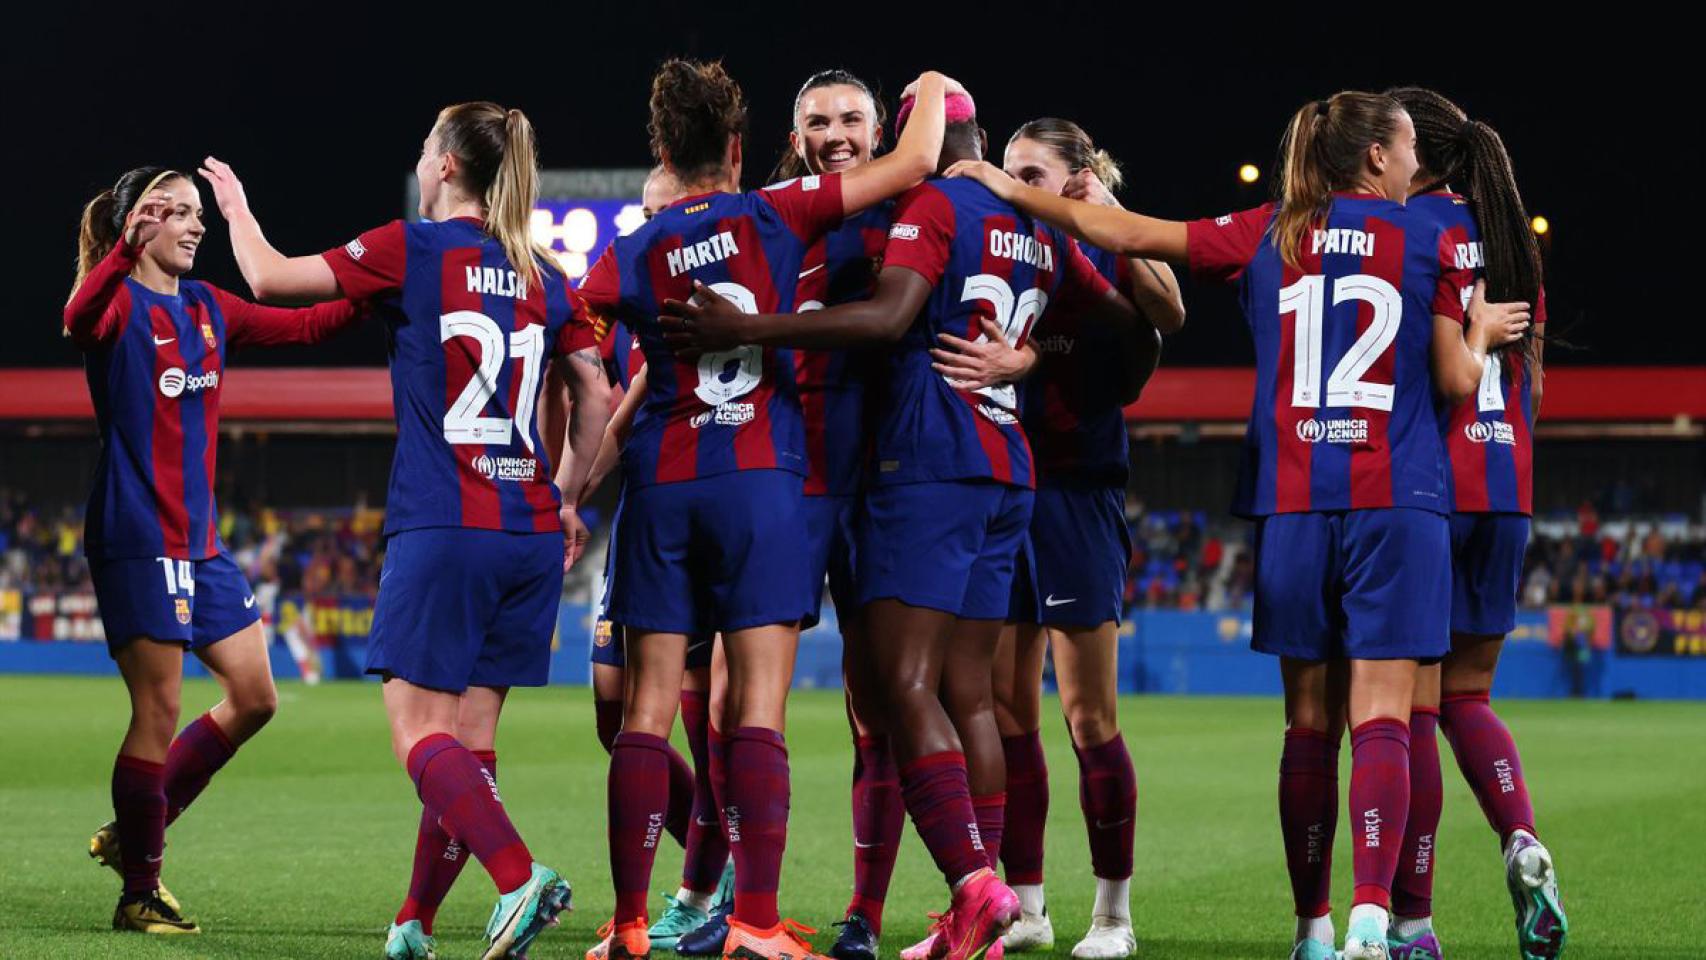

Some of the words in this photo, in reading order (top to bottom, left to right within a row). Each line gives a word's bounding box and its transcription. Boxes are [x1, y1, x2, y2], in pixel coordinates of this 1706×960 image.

[666, 231, 739, 277] MARTA
[1312, 229, 1375, 256] PATRI
[466, 266, 527, 300] WALSH
[1279, 274, 1403, 411] 12
[187, 370, 219, 391] Spotify
[439, 310, 546, 454] 21
[1327, 420, 1368, 429] UNHCR
[1327, 429, 1368, 439] ACNUR
[496, 457, 536, 468] UNHCR
[498, 466, 535, 477] ACNUR
[156, 557, 194, 597] 14
[1365, 808, 1382, 847] BARÇA
[1416, 834, 1432, 874] BARÇA
